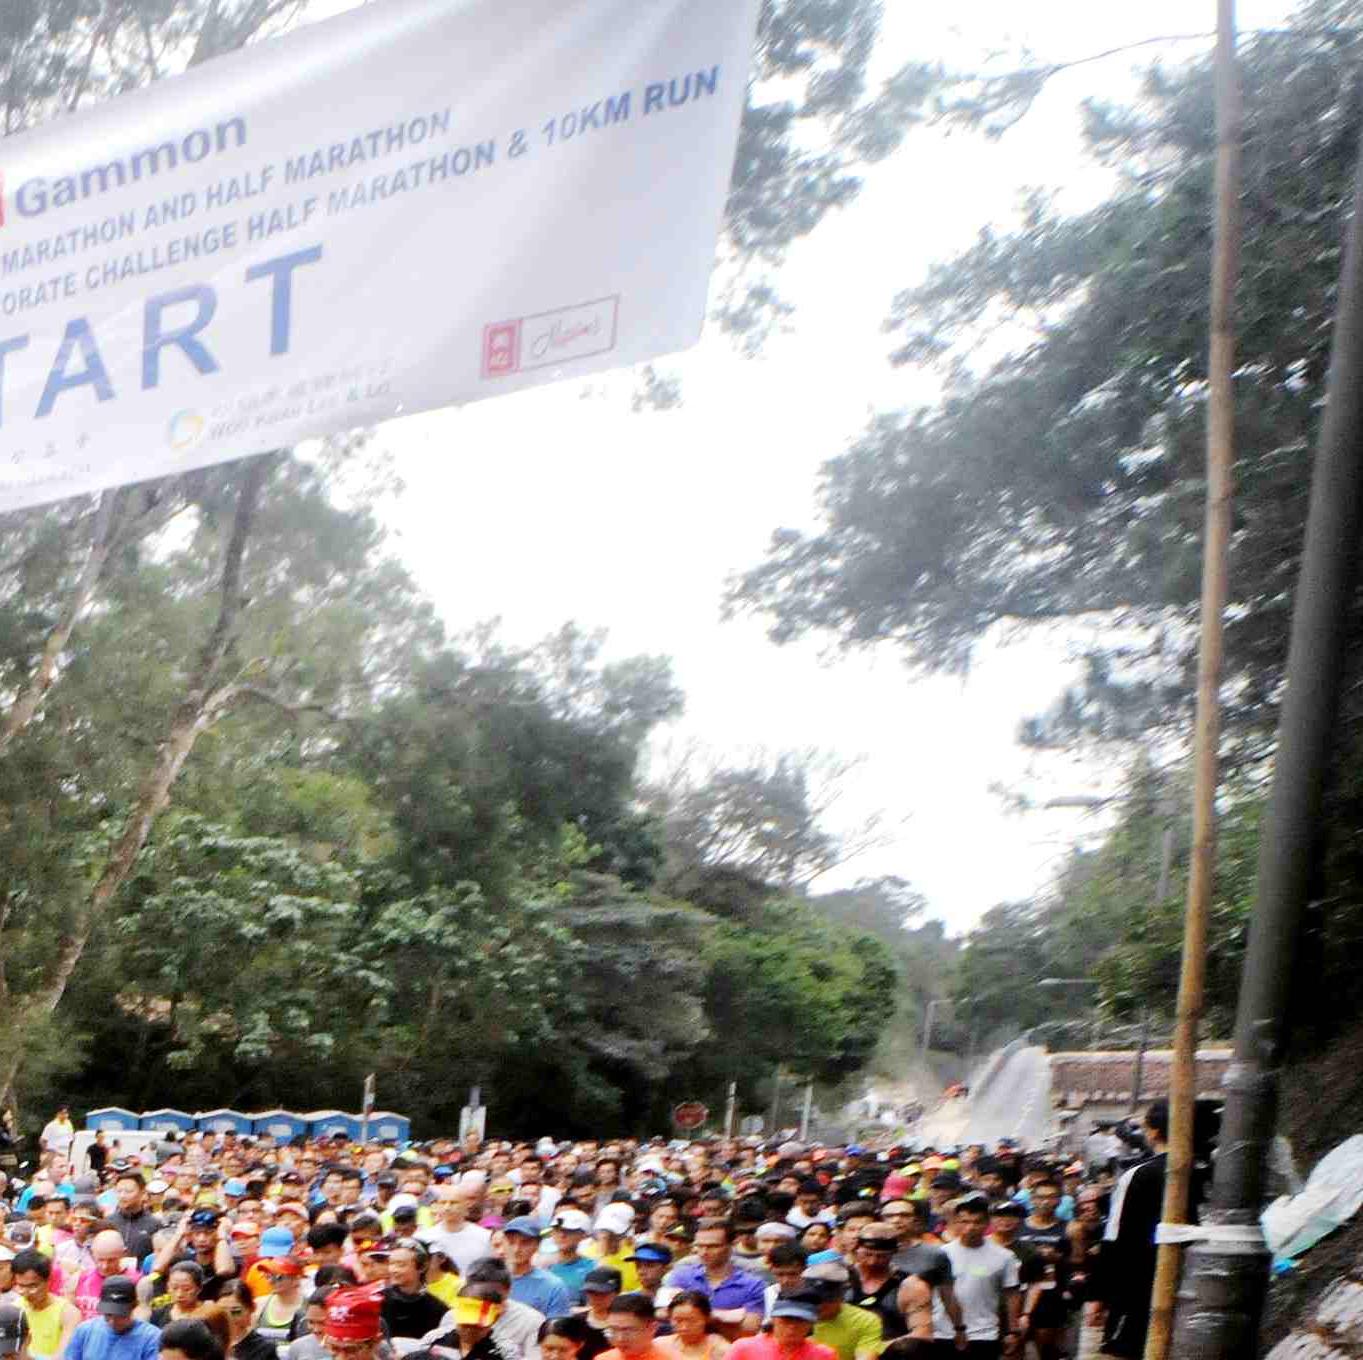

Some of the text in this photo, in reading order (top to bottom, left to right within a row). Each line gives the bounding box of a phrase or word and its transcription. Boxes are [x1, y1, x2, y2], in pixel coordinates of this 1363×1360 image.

[2, 211, 137, 278] MARATHON
[143, 193, 198, 231] AND
[206, 166, 275, 215] HALF
[284, 107, 451, 184] MARATHON
[15, 115, 247, 219] Gammon
[85, 219, 237, 291] CHALLENGE
[247, 198, 318, 241] HALF
[327, 139, 495, 217] MARATHON
[507, 127, 529, 161] &
[539, 92, 631, 147] 10KM
[642, 65, 720, 115] RUN
